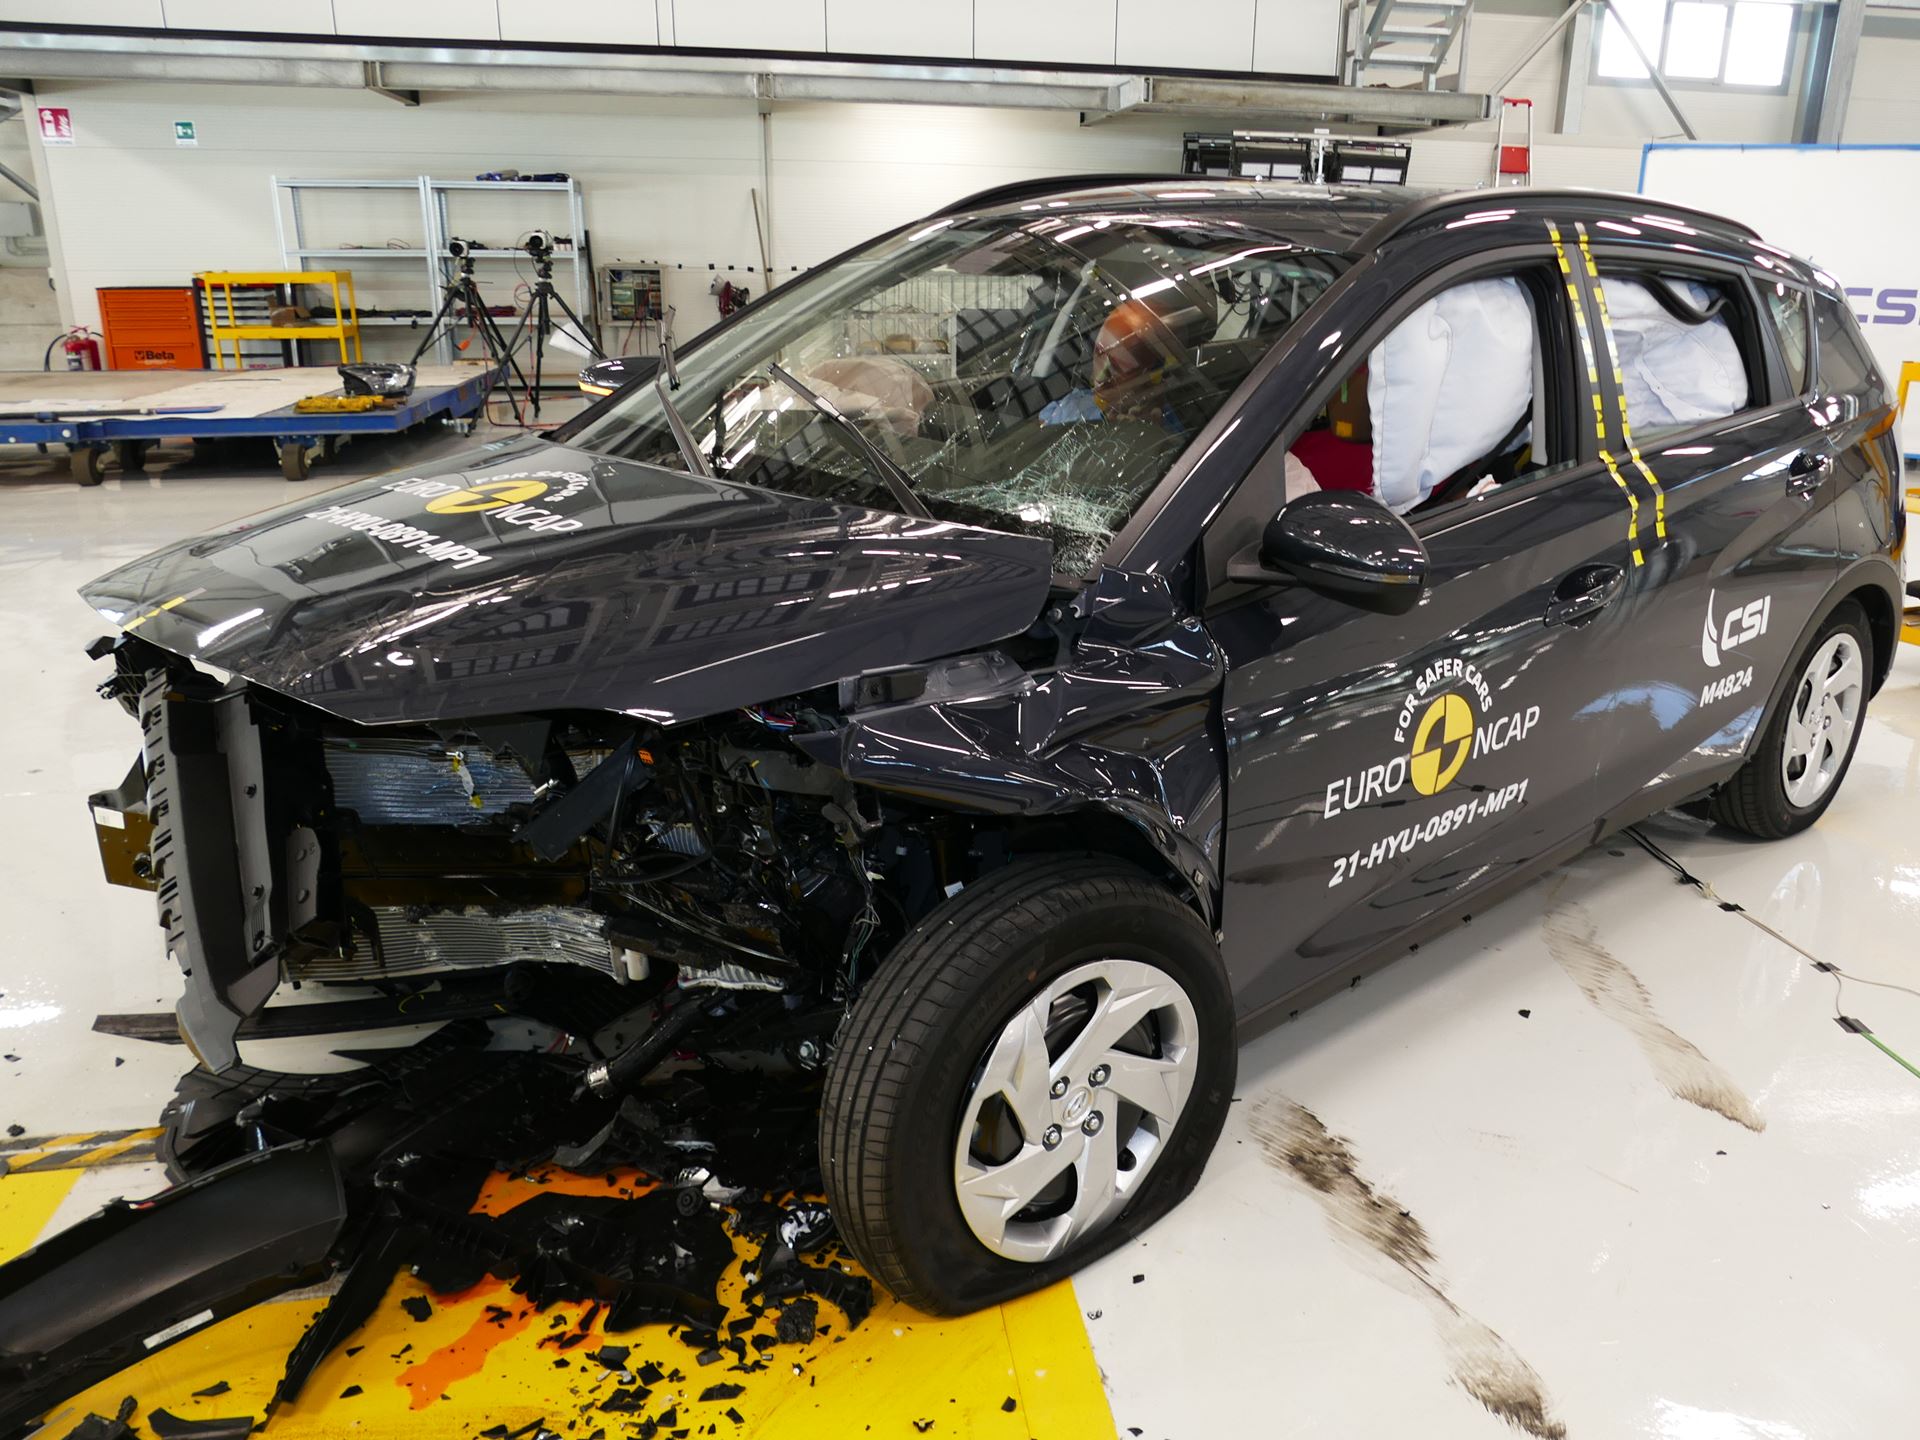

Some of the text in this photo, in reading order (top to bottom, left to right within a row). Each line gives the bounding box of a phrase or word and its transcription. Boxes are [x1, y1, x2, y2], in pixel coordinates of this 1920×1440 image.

[1844, 288, 1920, 325] CS
[146, 350, 175, 360] Beta
[381, 477, 584, 532] EURO NCAP
[475, 472, 528, 485] FOR
[304, 505, 493, 570] 21-HYU-0891-MP1
[1721, 595, 1771, 651] CSI
[1394, 658, 1493, 743] FOR SAFER CARS
[1699, 665, 1753, 708] M4824
[1323, 705, 1540, 820] EURO NCAP
[1328, 778, 1529, 889] 21-HYU-0891-MP1
